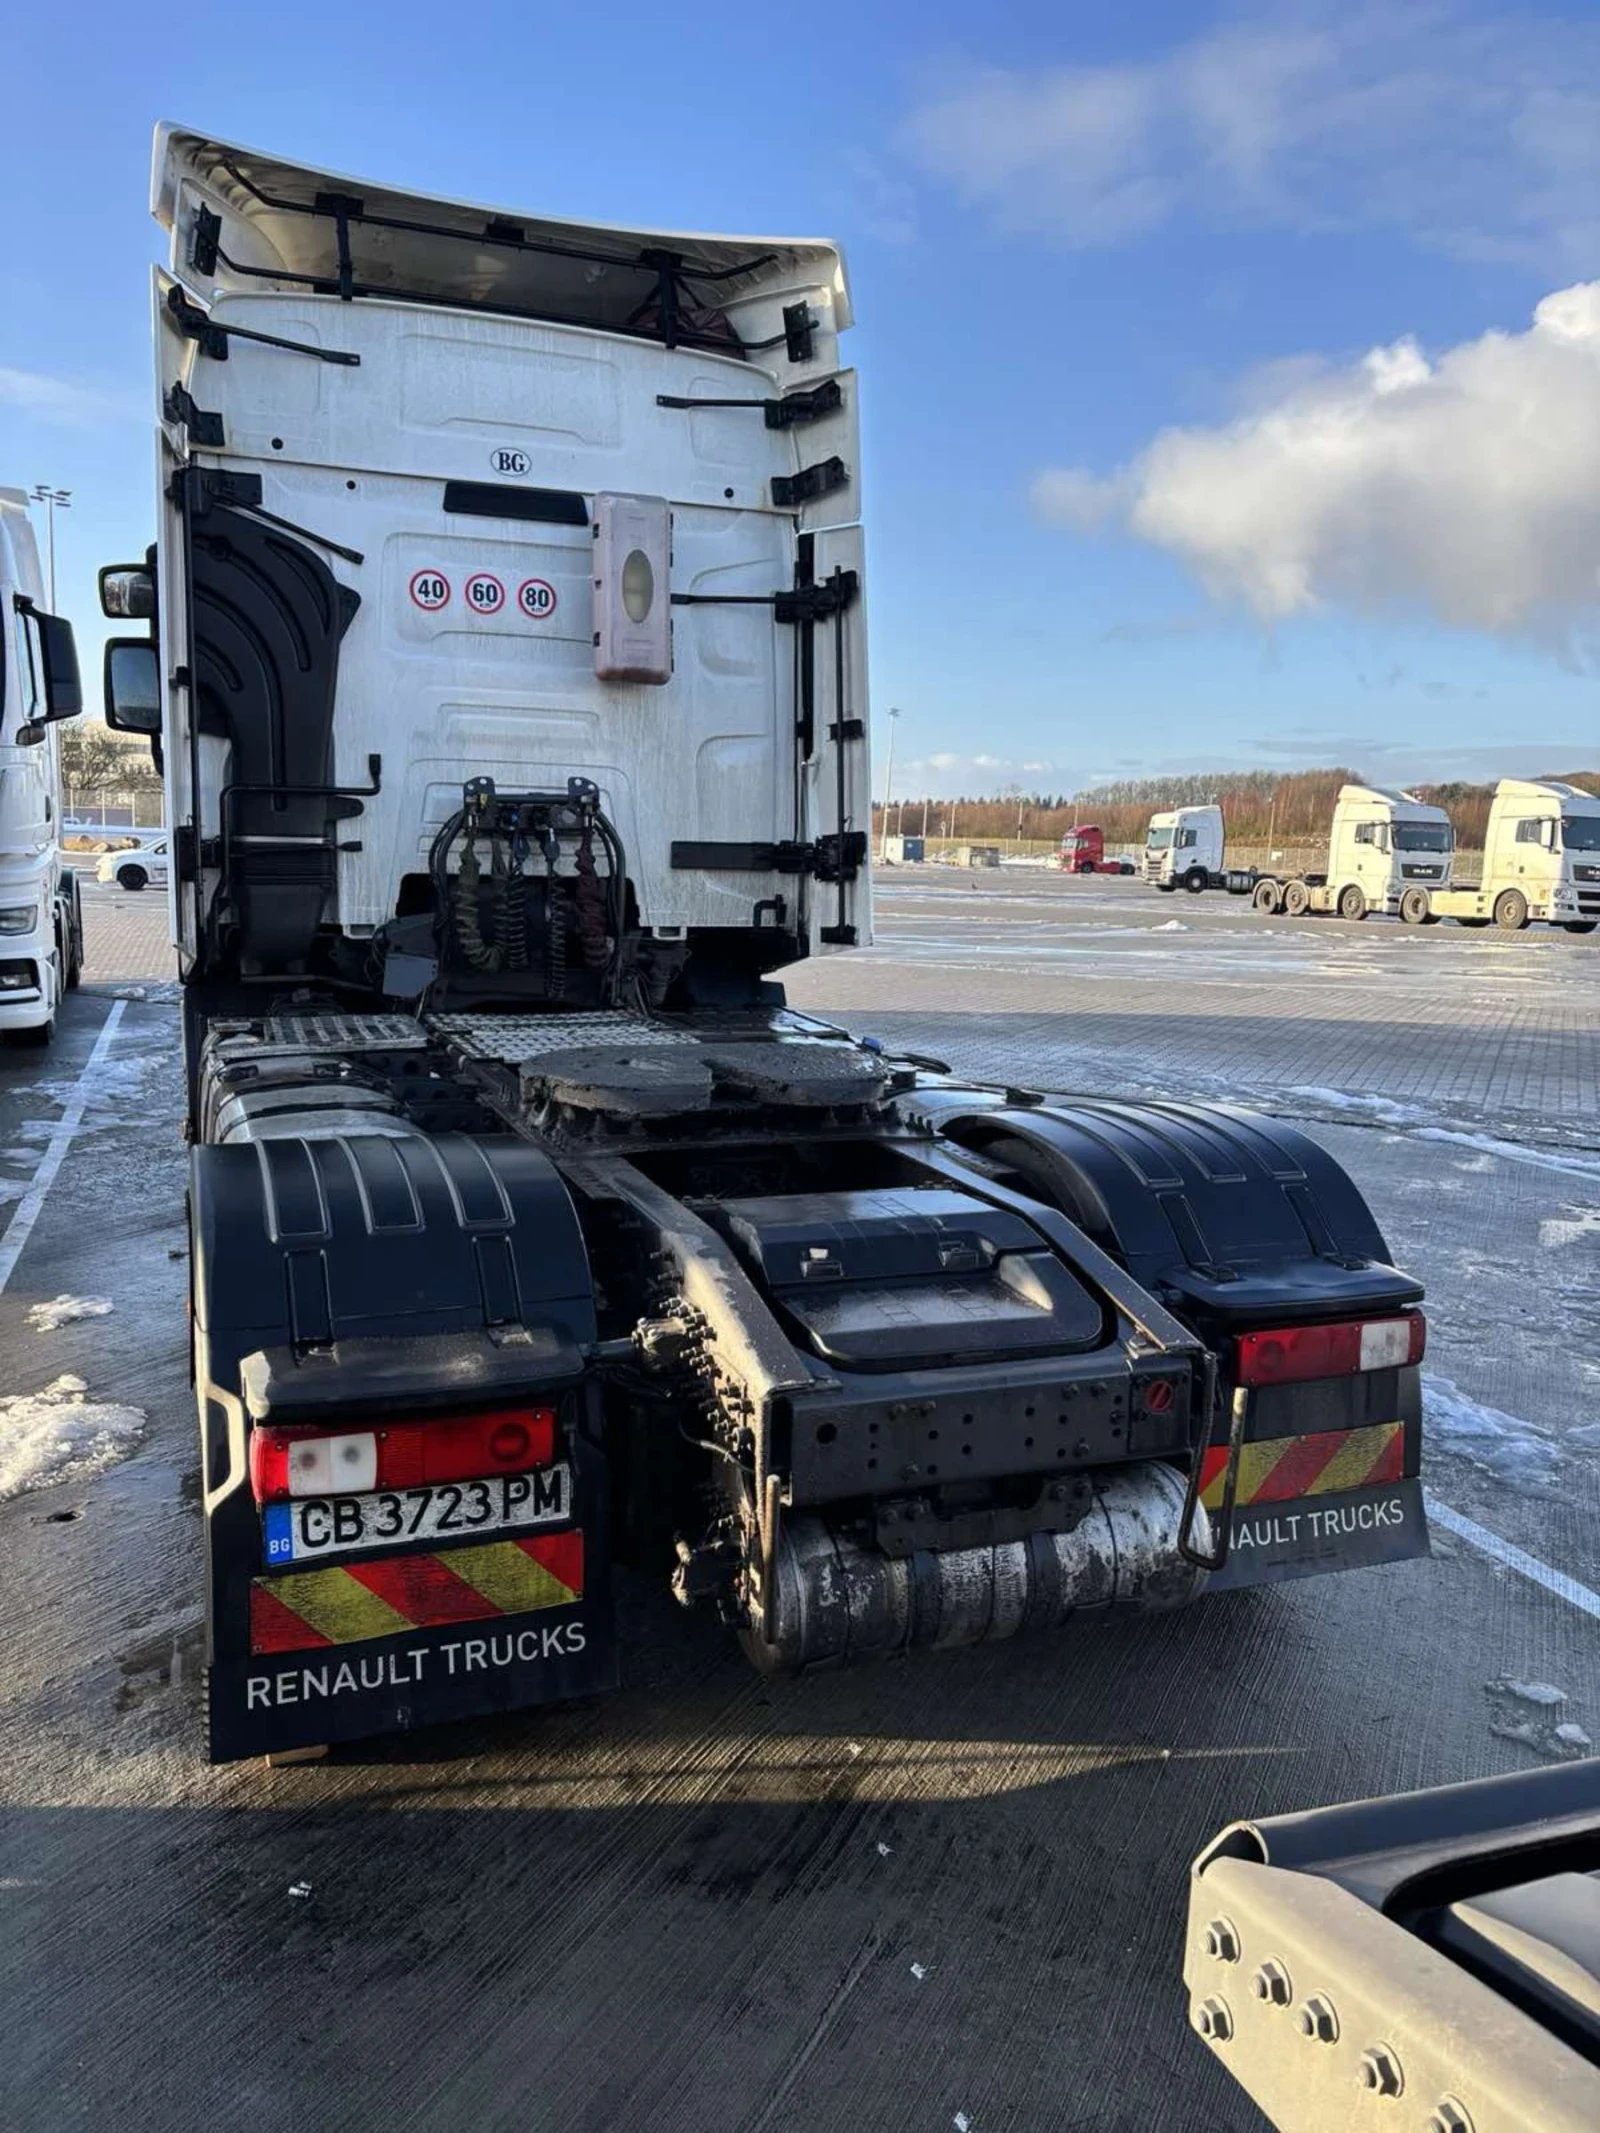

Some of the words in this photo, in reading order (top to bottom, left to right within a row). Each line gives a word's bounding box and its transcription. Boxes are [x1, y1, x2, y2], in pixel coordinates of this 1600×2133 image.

[499, 452, 525, 472] BG
[418, 579, 444, 598] 40
[473, 583, 497, 603] 60
[525, 587, 549, 607] 80
[301, 1499, 364, 1548] CB
[376, 1483, 491, 1537] 3723
[502, 1470, 562, 1521] PM
[1308, 1500, 1404, 1537] TRUCKS
[270, 1538, 290, 1554] BG
[247, 1648, 429, 1710] RENAULT
[440, 1622, 586, 1673] TRUCKS
